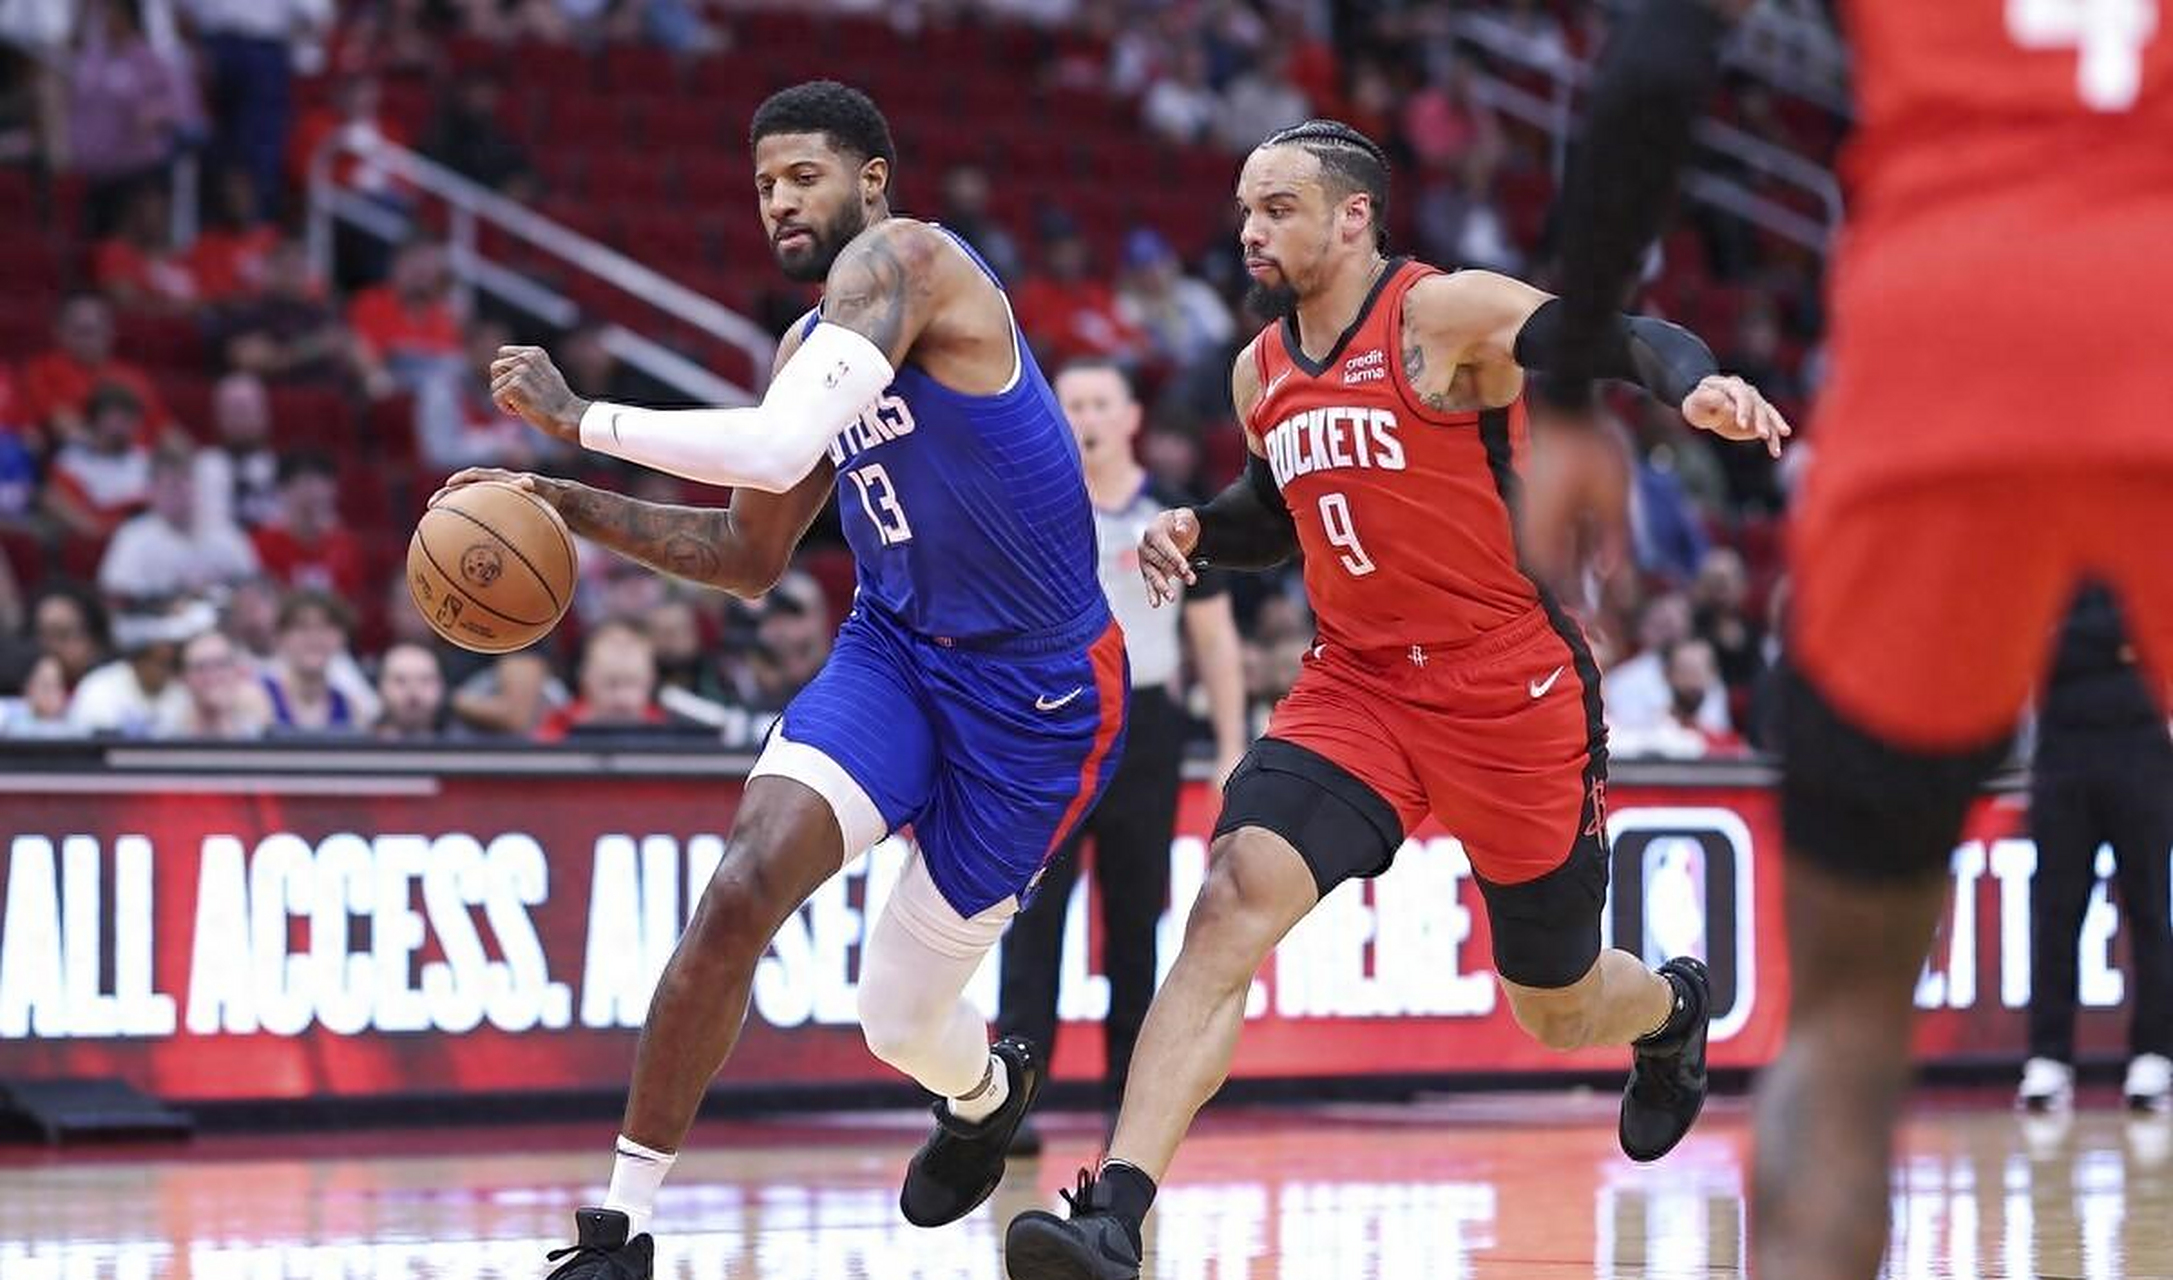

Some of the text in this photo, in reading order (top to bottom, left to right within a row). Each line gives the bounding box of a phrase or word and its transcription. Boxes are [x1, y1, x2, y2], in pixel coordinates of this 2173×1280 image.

[1343, 367, 1385, 384] karma
[1345, 349, 1384, 370] credit
[1263, 405, 1407, 493] ROCKETS
[846, 462, 914, 546] 13
[1318, 492, 1377, 577] 9
[0, 834, 177, 1038] ALL
[185, 832, 571, 1034] ACCESS.
